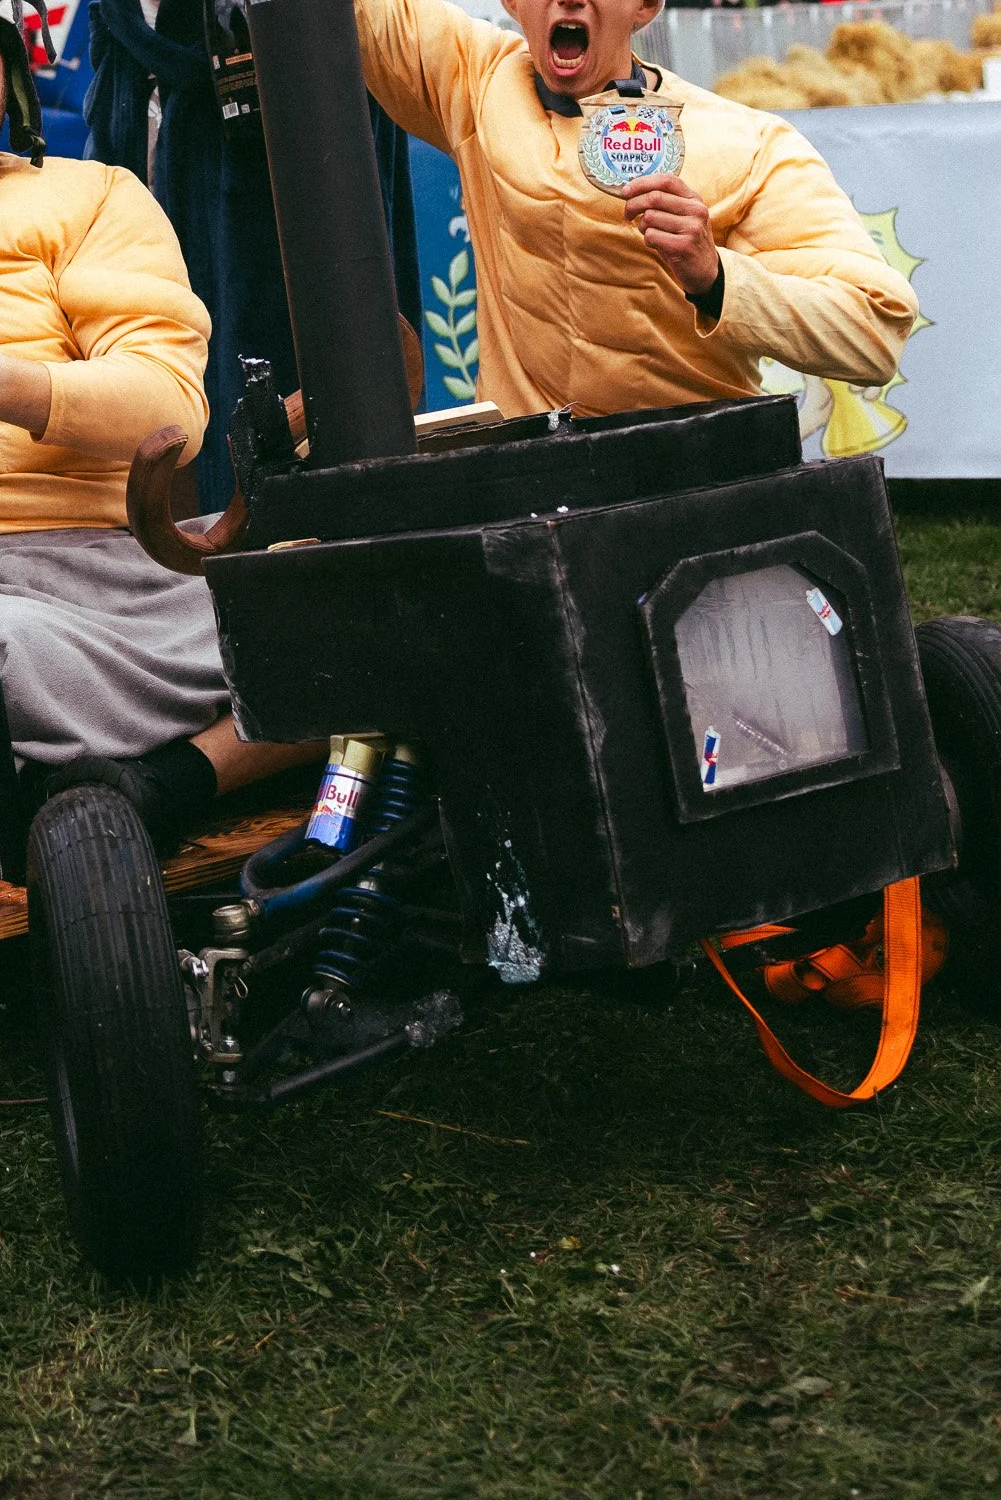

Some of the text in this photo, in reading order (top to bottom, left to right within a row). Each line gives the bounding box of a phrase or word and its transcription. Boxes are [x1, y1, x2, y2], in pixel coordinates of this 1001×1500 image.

[603, 137, 661, 151] Red Bull
[611, 152, 655, 164] SOAPBOX
[621, 164, 644, 174] RACE
[325, 784, 359, 809] Bull
